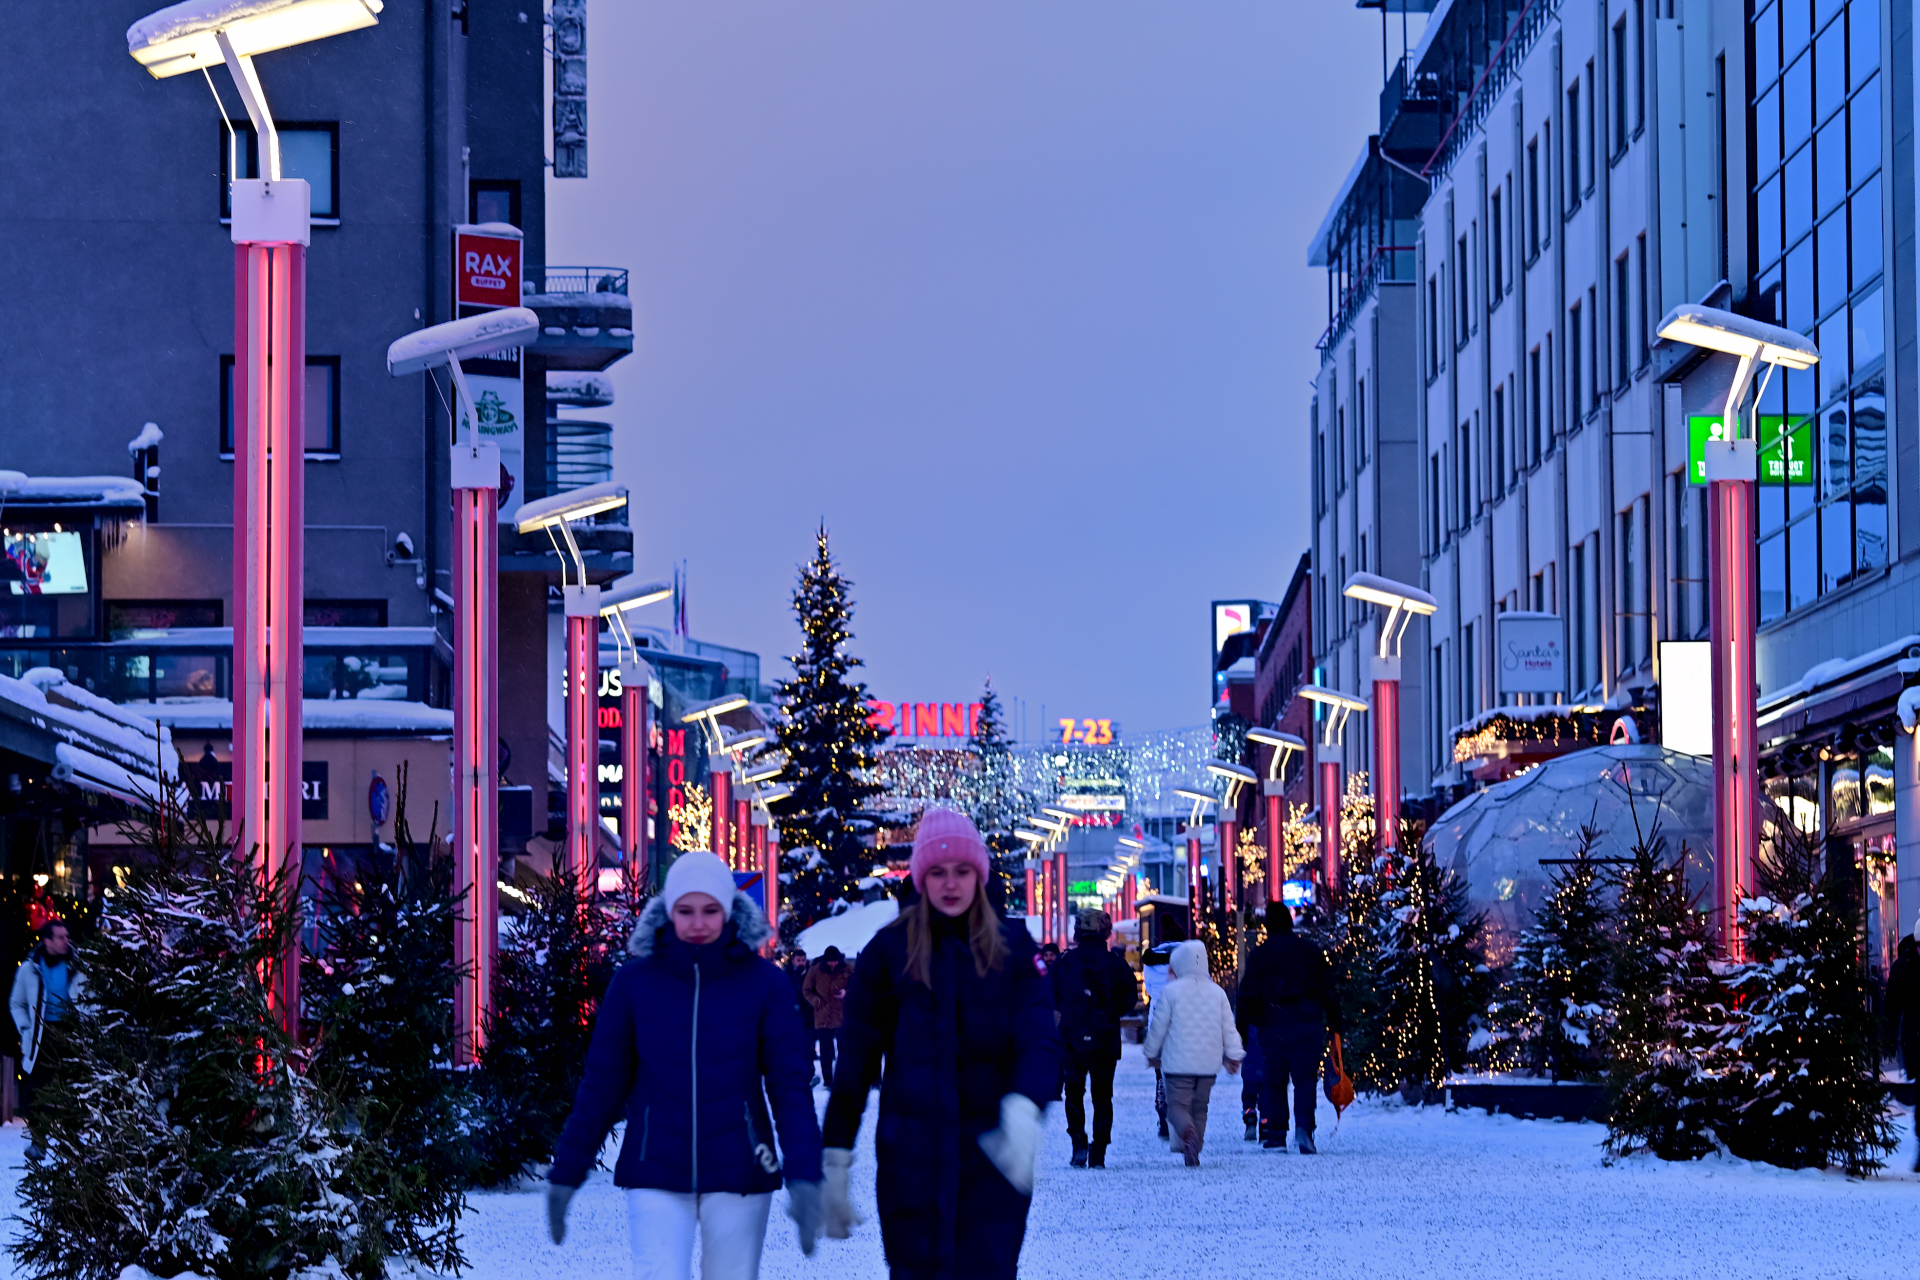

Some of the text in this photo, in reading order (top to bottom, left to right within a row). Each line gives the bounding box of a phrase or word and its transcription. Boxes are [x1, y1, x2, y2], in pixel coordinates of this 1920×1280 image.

[465, 251, 512, 278] RAX
[1503, 641, 1560, 671] Santa's
[1524, 660, 1552, 668] Hotels
[1059, 718, 1113, 745] 7-23
